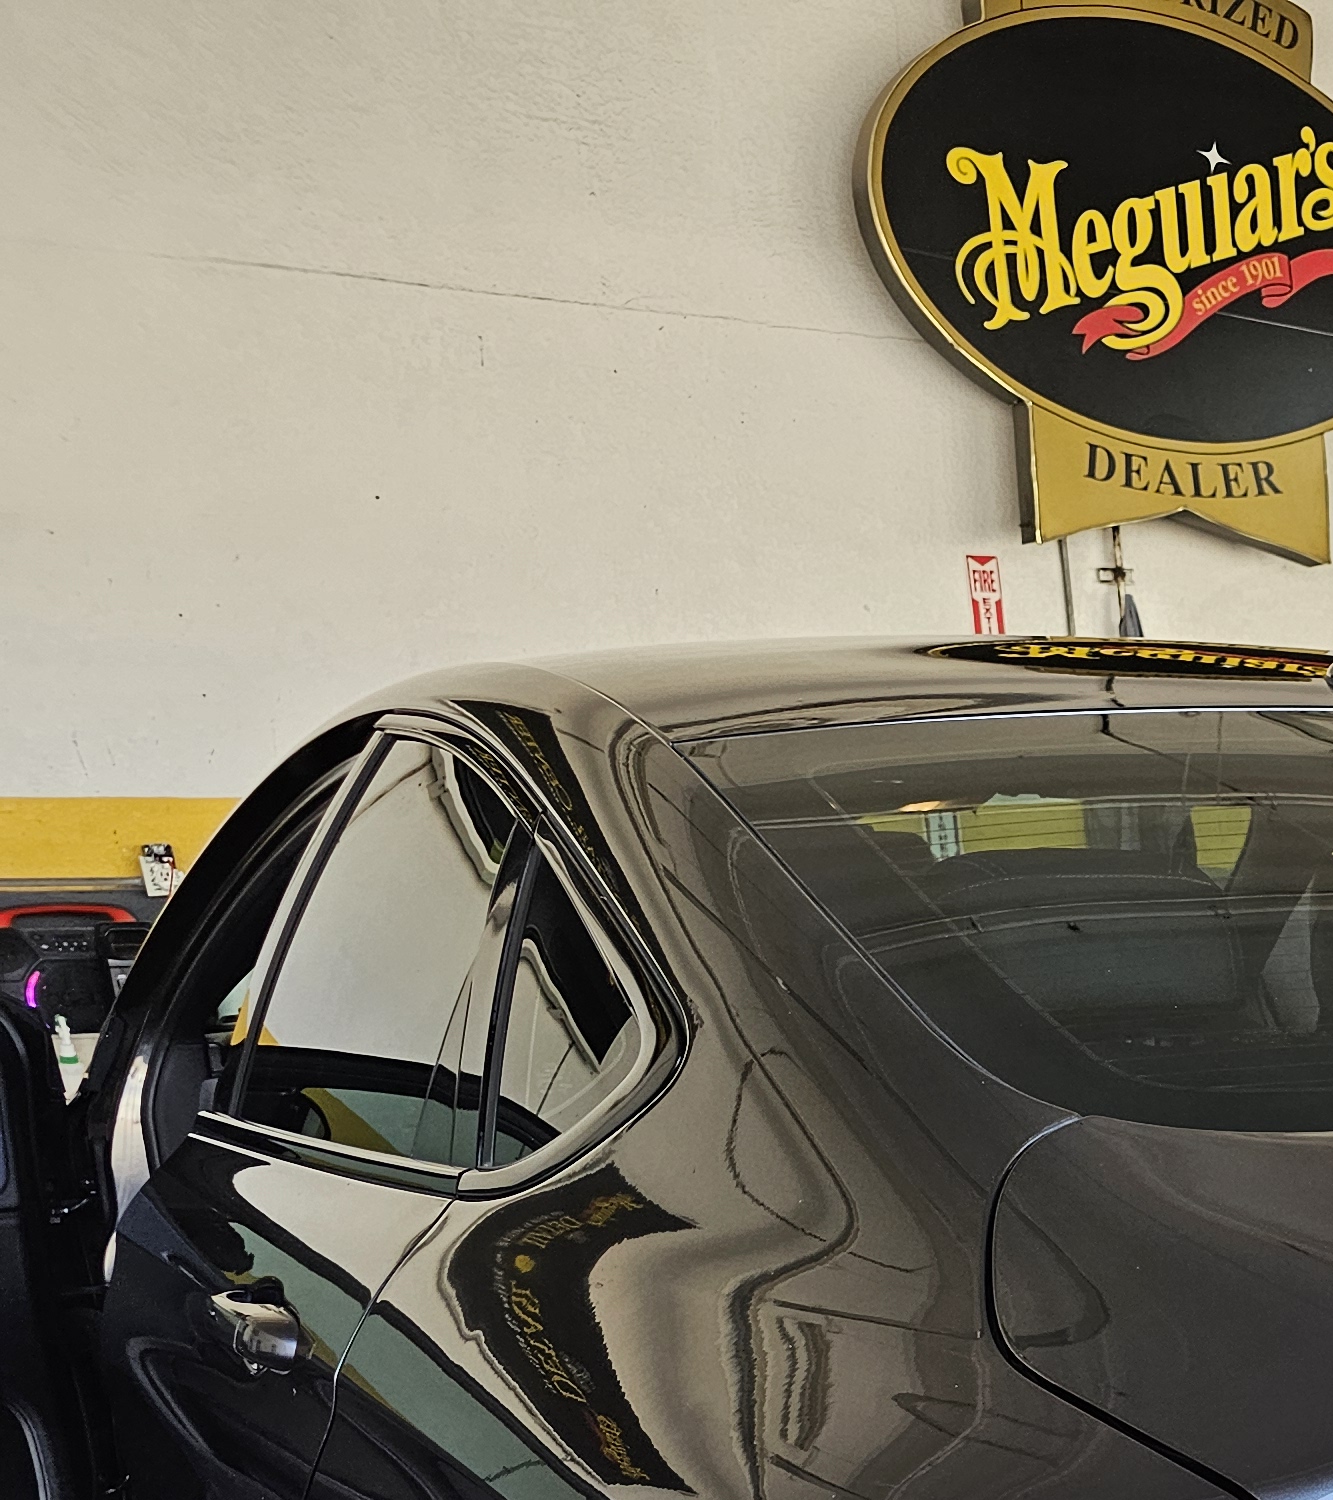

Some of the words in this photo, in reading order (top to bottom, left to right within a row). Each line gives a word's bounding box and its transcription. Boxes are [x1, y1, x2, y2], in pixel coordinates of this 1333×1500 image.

[1180, 0, 1299, 50] ZED
[1191, 271, 1240, 317] since
[1244, 256, 1282, 289] 1901
[1084, 441, 1284, 499] DEALER
[972, 569, 997, 593] FIRE
